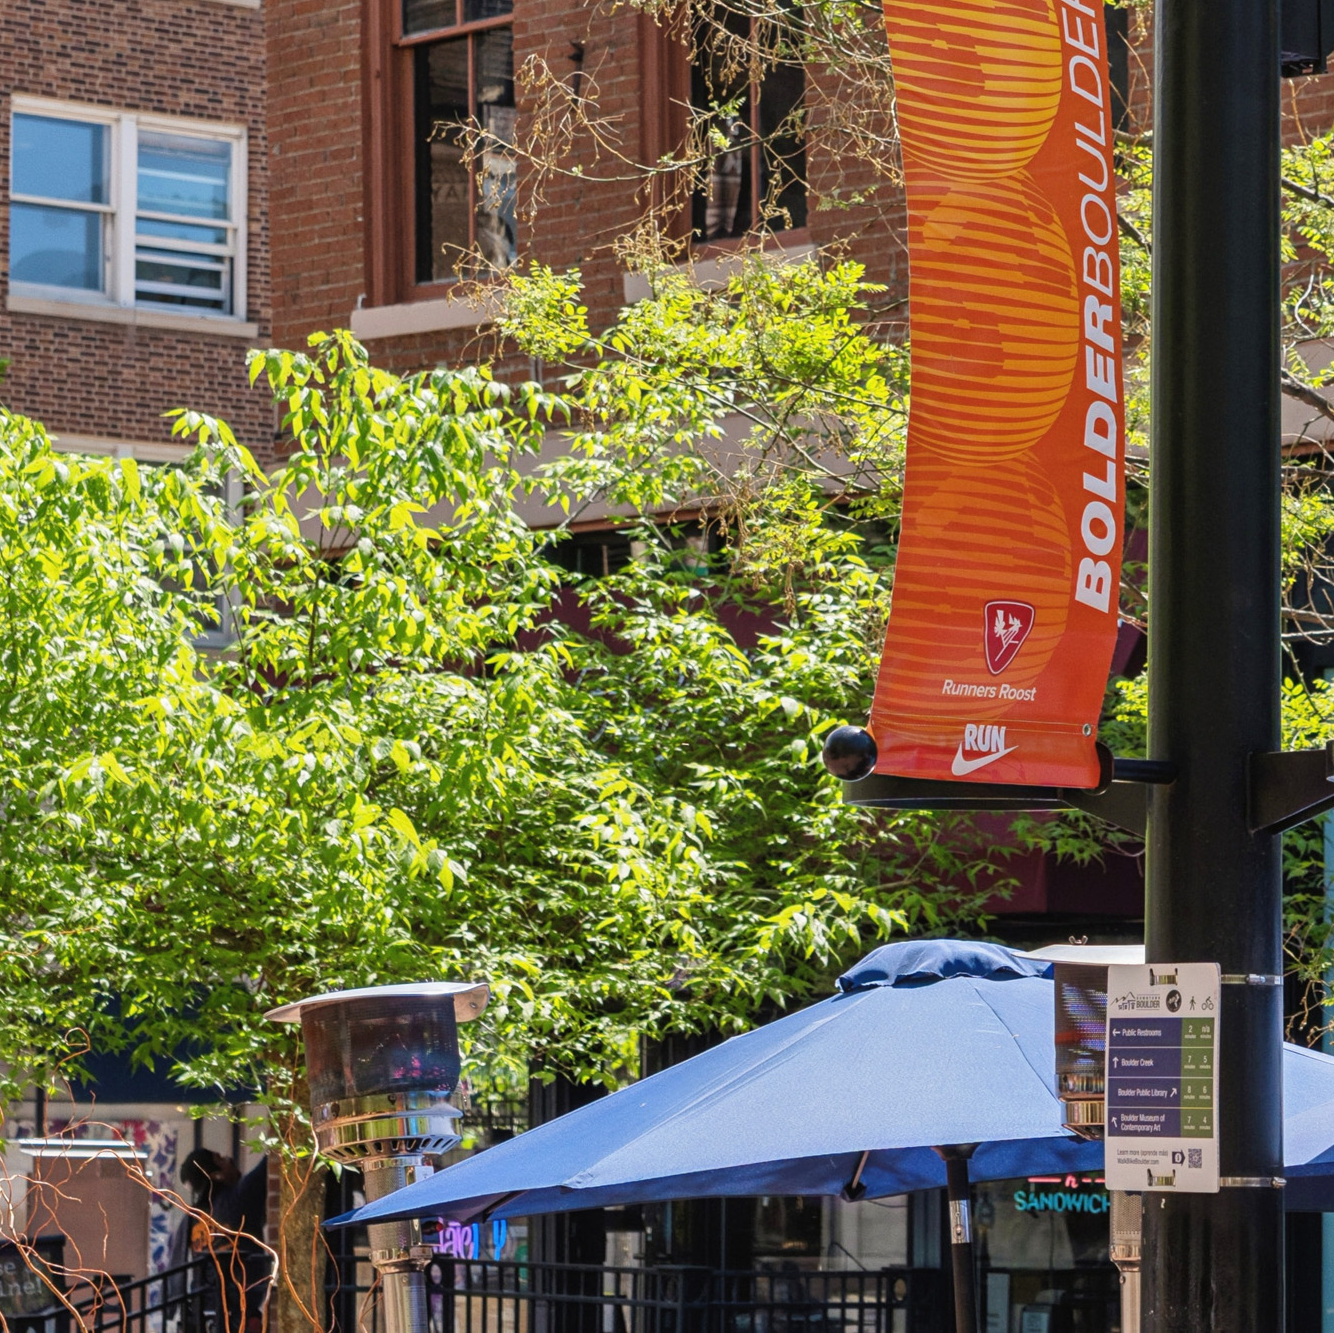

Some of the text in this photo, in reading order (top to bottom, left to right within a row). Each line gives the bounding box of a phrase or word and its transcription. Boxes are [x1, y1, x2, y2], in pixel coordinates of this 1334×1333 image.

[941, 679, 1037, 701] Runners Roost
[964, 723, 1007, 753] RUN
[1136, 1000, 1160, 1009] BOULDER
[1121, 1028, 1162, 1037] Public Restrooms
[1188, 1025, 1193, 1033] 2
[1121, 1058, 1154, 1066] Boulder Creek
[1188, 1055, 1208, 1063] 7 5
[1117, 1088, 1168, 1098] Boulder Public Library
[1187, 1085, 1192, 1094] 8
[1120, 1113, 1165, 1122] Boulder Museum of
[1187, 1116, 1207, 1124] 7 4
[1120, 1123, 1161, 1133] Contemporary Art
